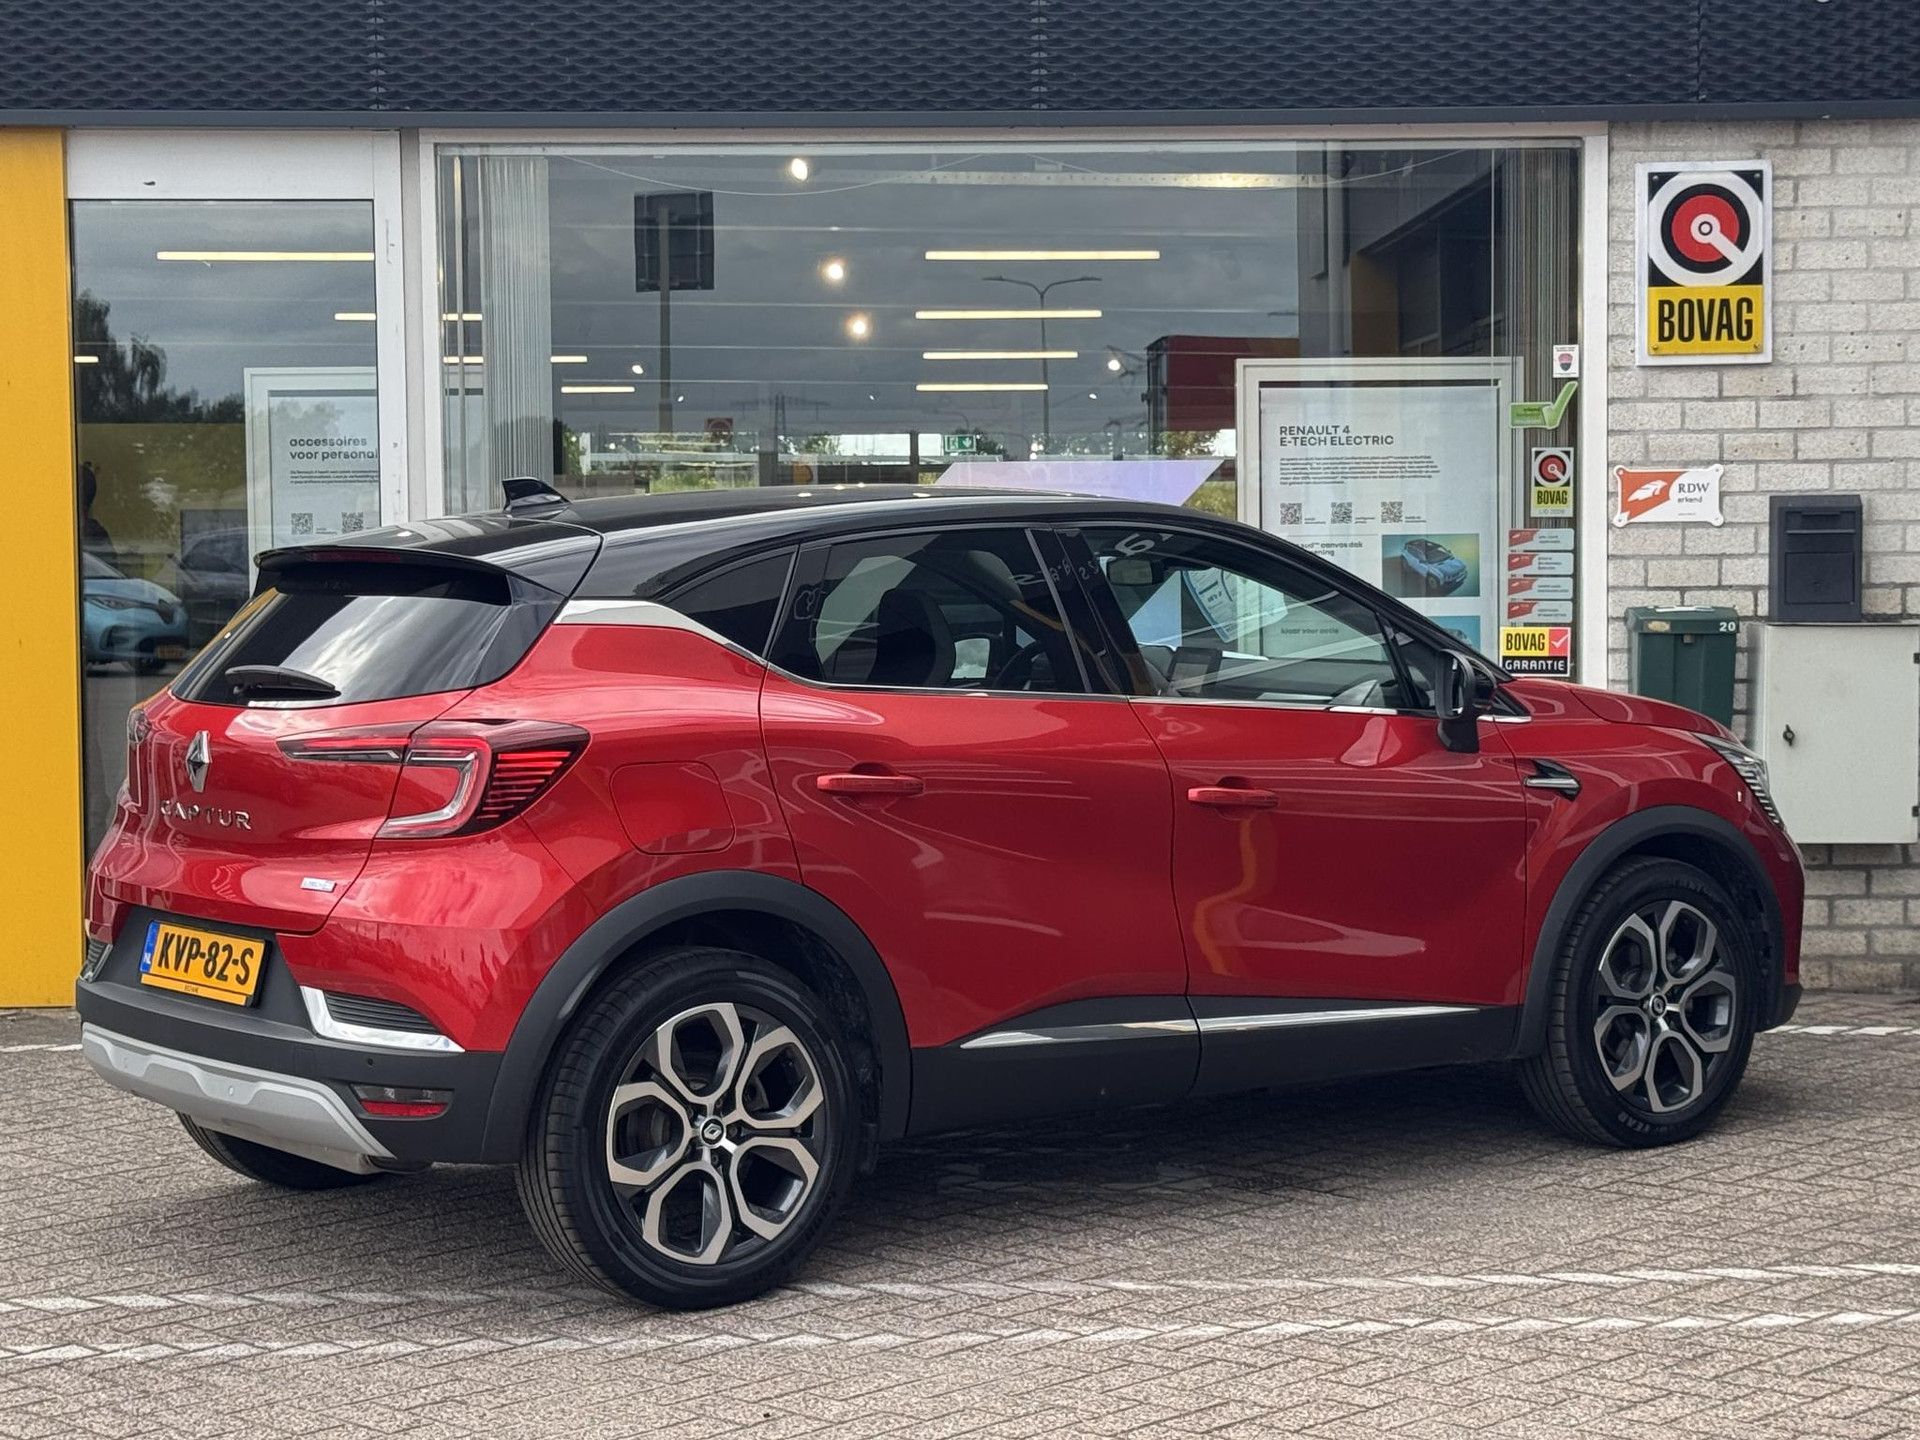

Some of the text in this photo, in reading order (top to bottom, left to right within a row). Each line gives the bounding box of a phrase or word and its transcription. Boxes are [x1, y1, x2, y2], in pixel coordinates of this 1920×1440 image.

[1658, 297, 1753, 342] BOVAG
[1279, 425, 1351, 436] RENAULT 4
[289, 436, 367, 447] accessoires
[1279, 435, 1394, 447] E-TECH ELECTRIC
[289, 450, 319, 460] voor
[1678, 482, 1710, 494] RDW
[1537, 490, 1568, 505] BOVAG
[1719, 621, 1736, 632] 20
[1505, 633, 1546, 651] BOVAG
[1505, 660, 1565, 671] GARANTIE
[160, 800, 252, 831] CAPTUR
[157, 932, 255, 986] KVP-82-S
